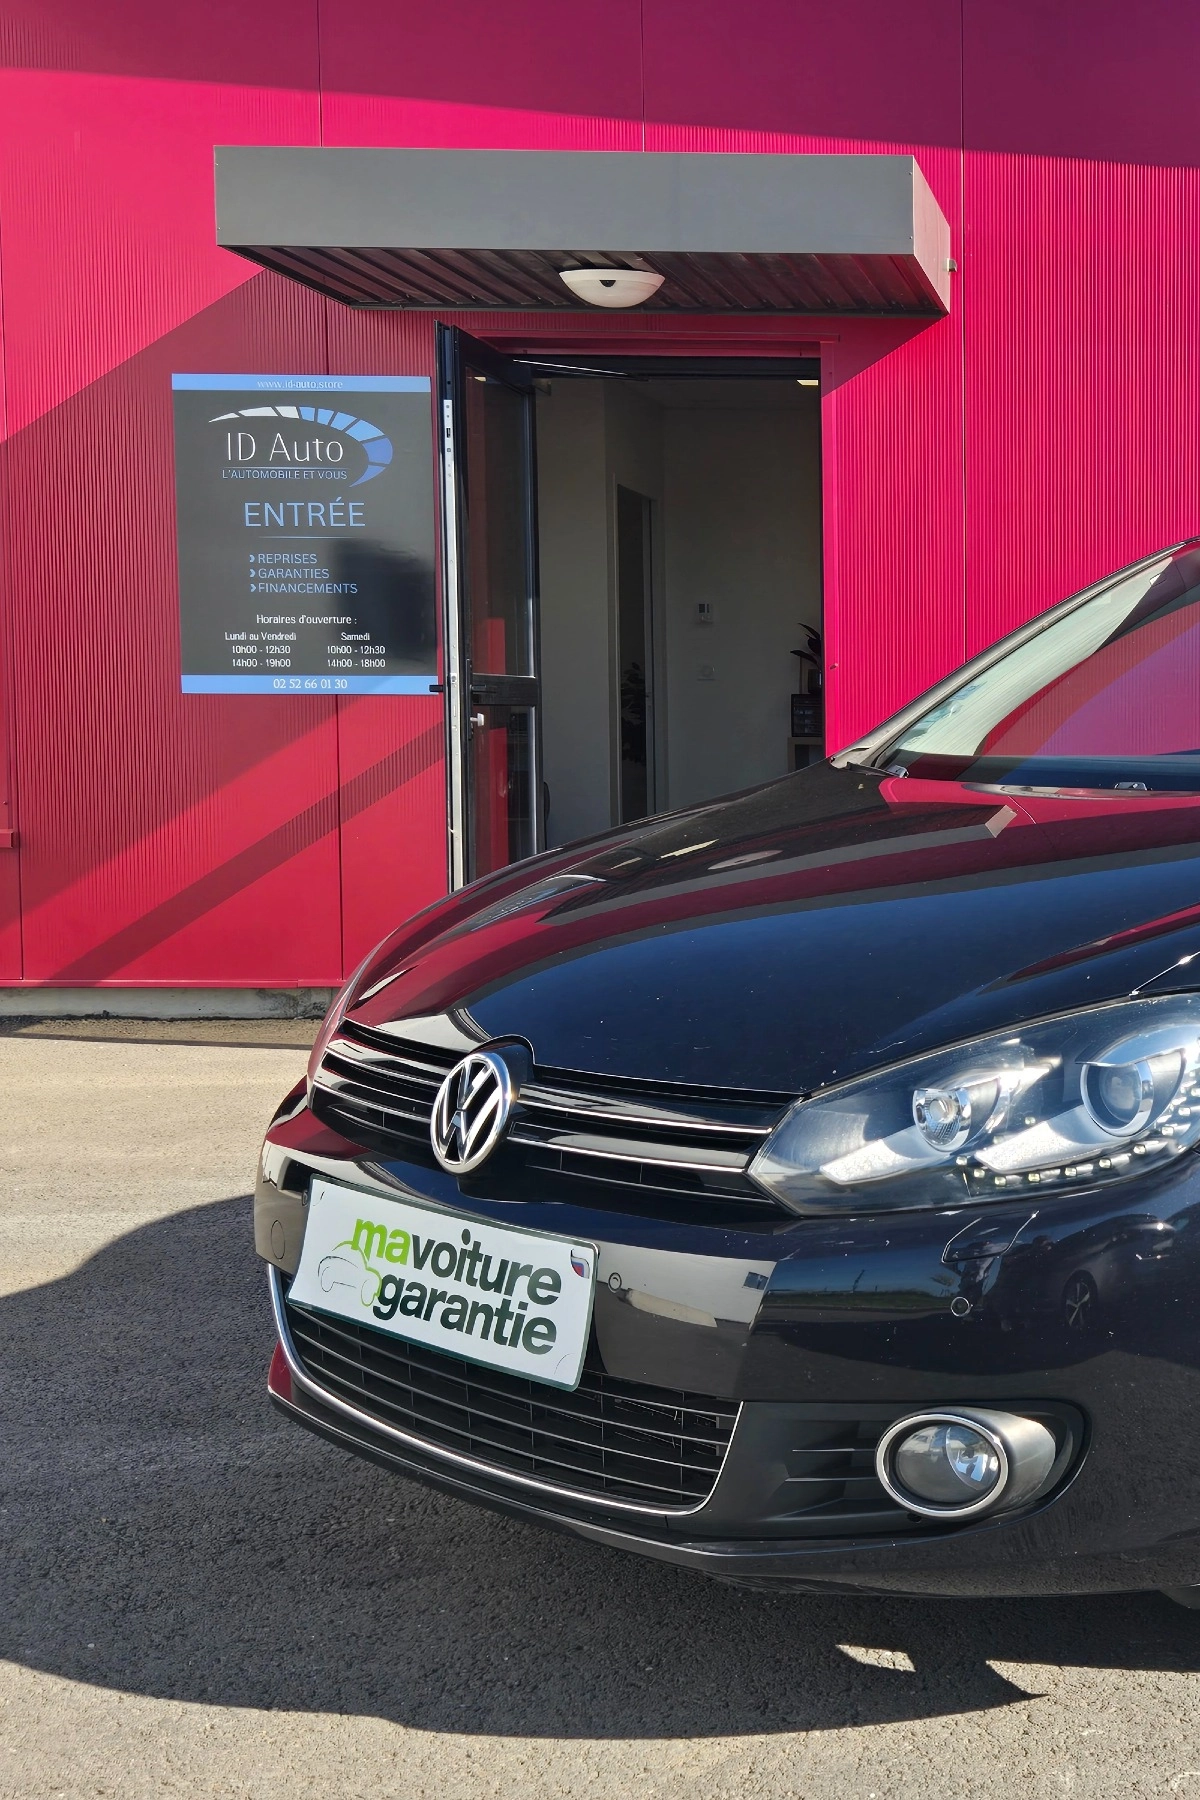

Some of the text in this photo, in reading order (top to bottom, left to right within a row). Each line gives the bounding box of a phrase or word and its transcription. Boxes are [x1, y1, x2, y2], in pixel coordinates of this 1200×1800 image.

[257, 379, 344, 389] www.id-auto.store
[227, 432, 344, 463] ID Auto
[222, 469, 348, 481] L'AUTOMOBILE ET VOUS
[244, 496, 366, 527] ENTRÉE
[257, 553, 318, 564] REPRISES
[258, 568, 330, 579] GARANTIES
[258, 582, 358, 594] FINANCEMENTS
[256, 614, 297, 624] Horaires
[299, 614, 352, 625] d'ouverture
[224, 631, 297, 641] Lundi au Vendredi
[340, 631, 371, 641] Samedi
[232, 645, 258, 654] 10h00
[265, 645, 291, 654] 12h30
[327, 645, 353, 654] 10h00
[360, 645, 386, 655] 12h30
[232, 658, 258, 668] 14h00
[265, 658, 291, 668] 19h00
[327, 658, 353, 668] 14h00
[360, 658, 386, 668] 18h00
[273, 678, 348, 689] 02 52 66 01 30
[351, 1218, 563, 1306] mavoiture
[371, 1273, 558, 1355] garantie
